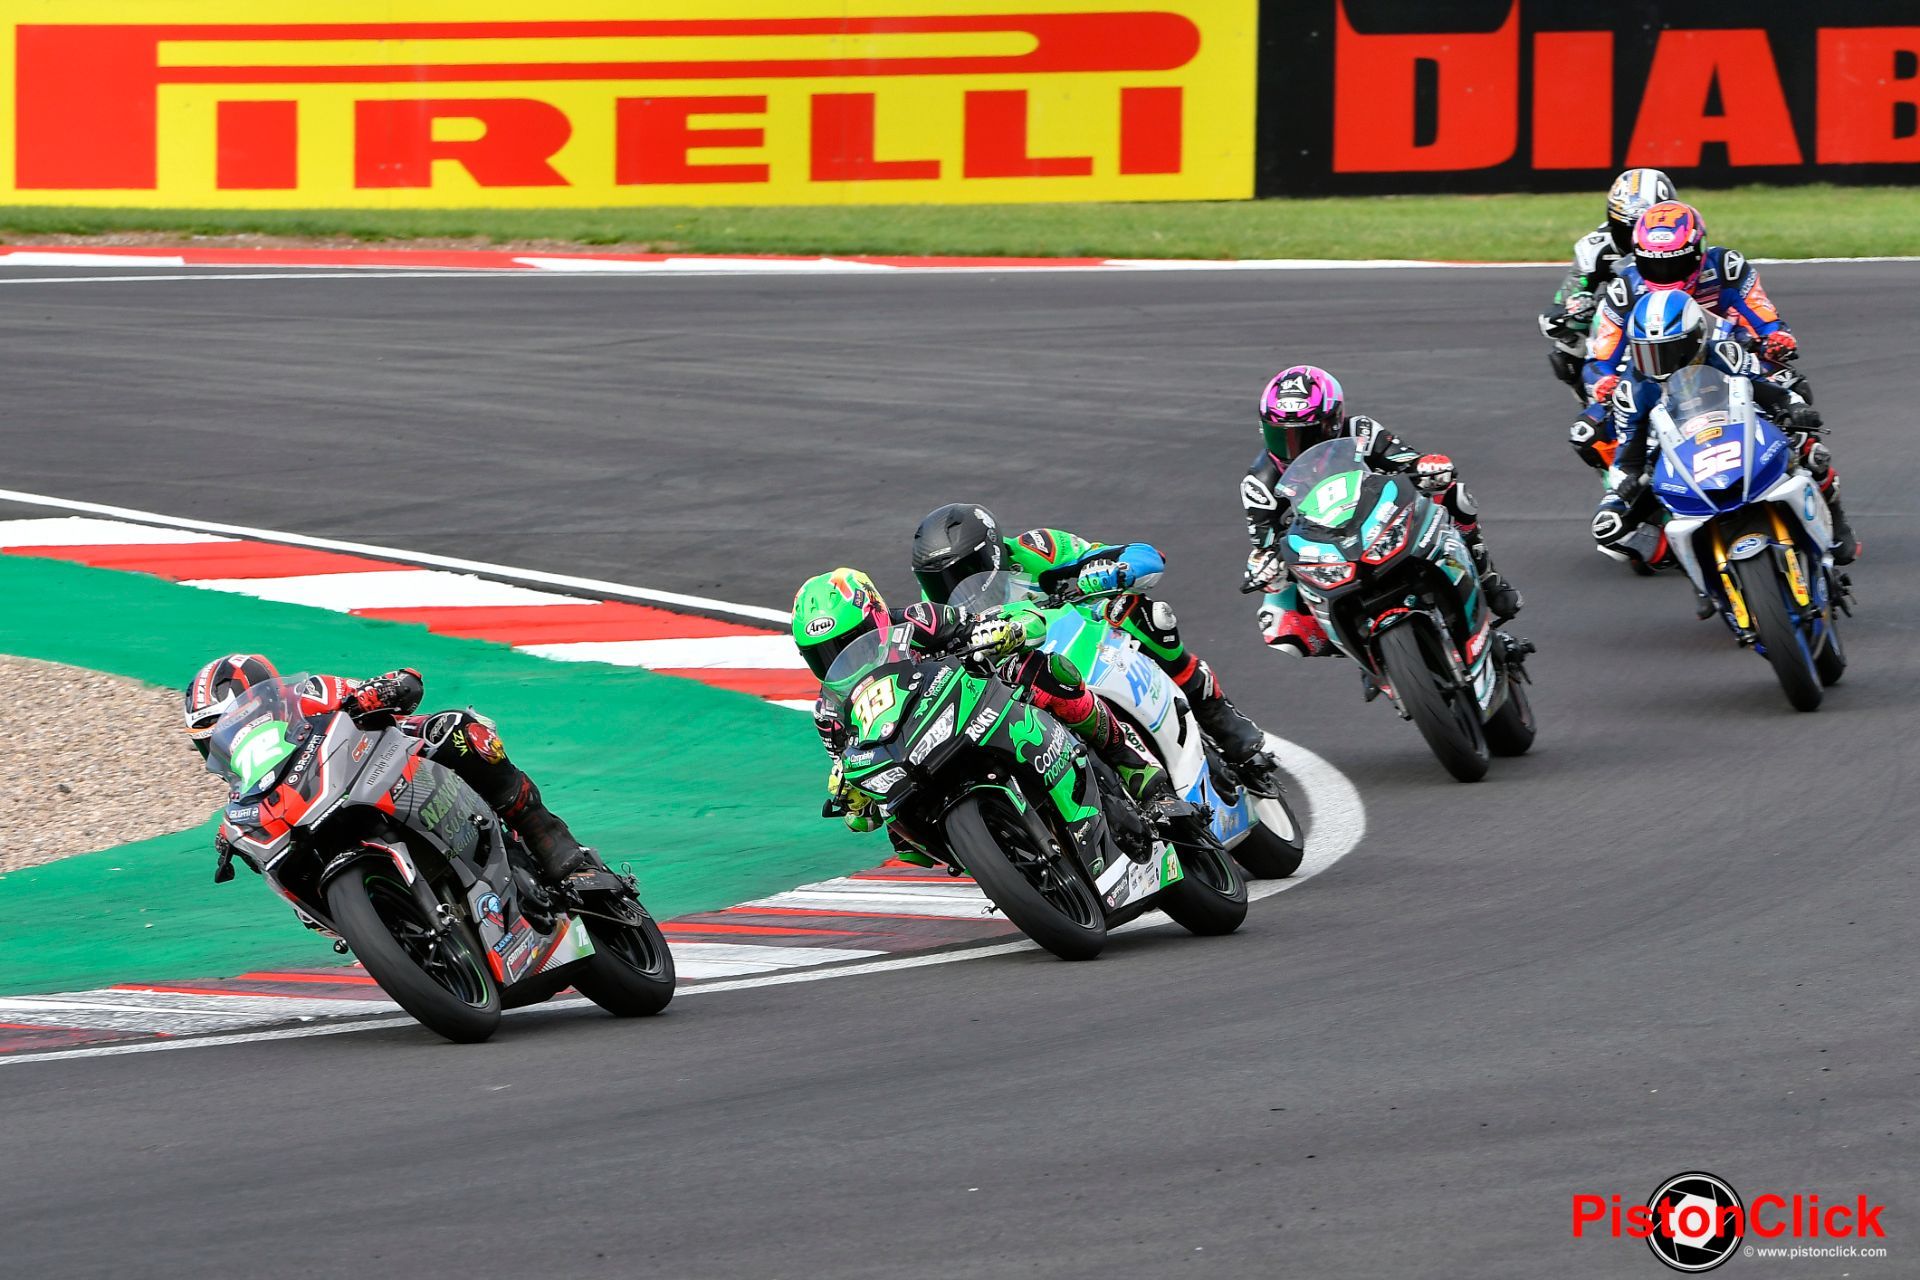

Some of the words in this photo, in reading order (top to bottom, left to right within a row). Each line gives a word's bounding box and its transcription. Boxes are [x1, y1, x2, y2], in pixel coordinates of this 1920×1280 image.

[15, 11, 1201, 190] PIRELLI
[1277, 401, 1307, 410] KYT
[1693, 440, 1742, 483] 52
[1316, 477, 1348, 513] 8
[811, 621, 832, 632] Arai
[854, 678, 896, 739] 33
[234, 726, 285, 786] 72
